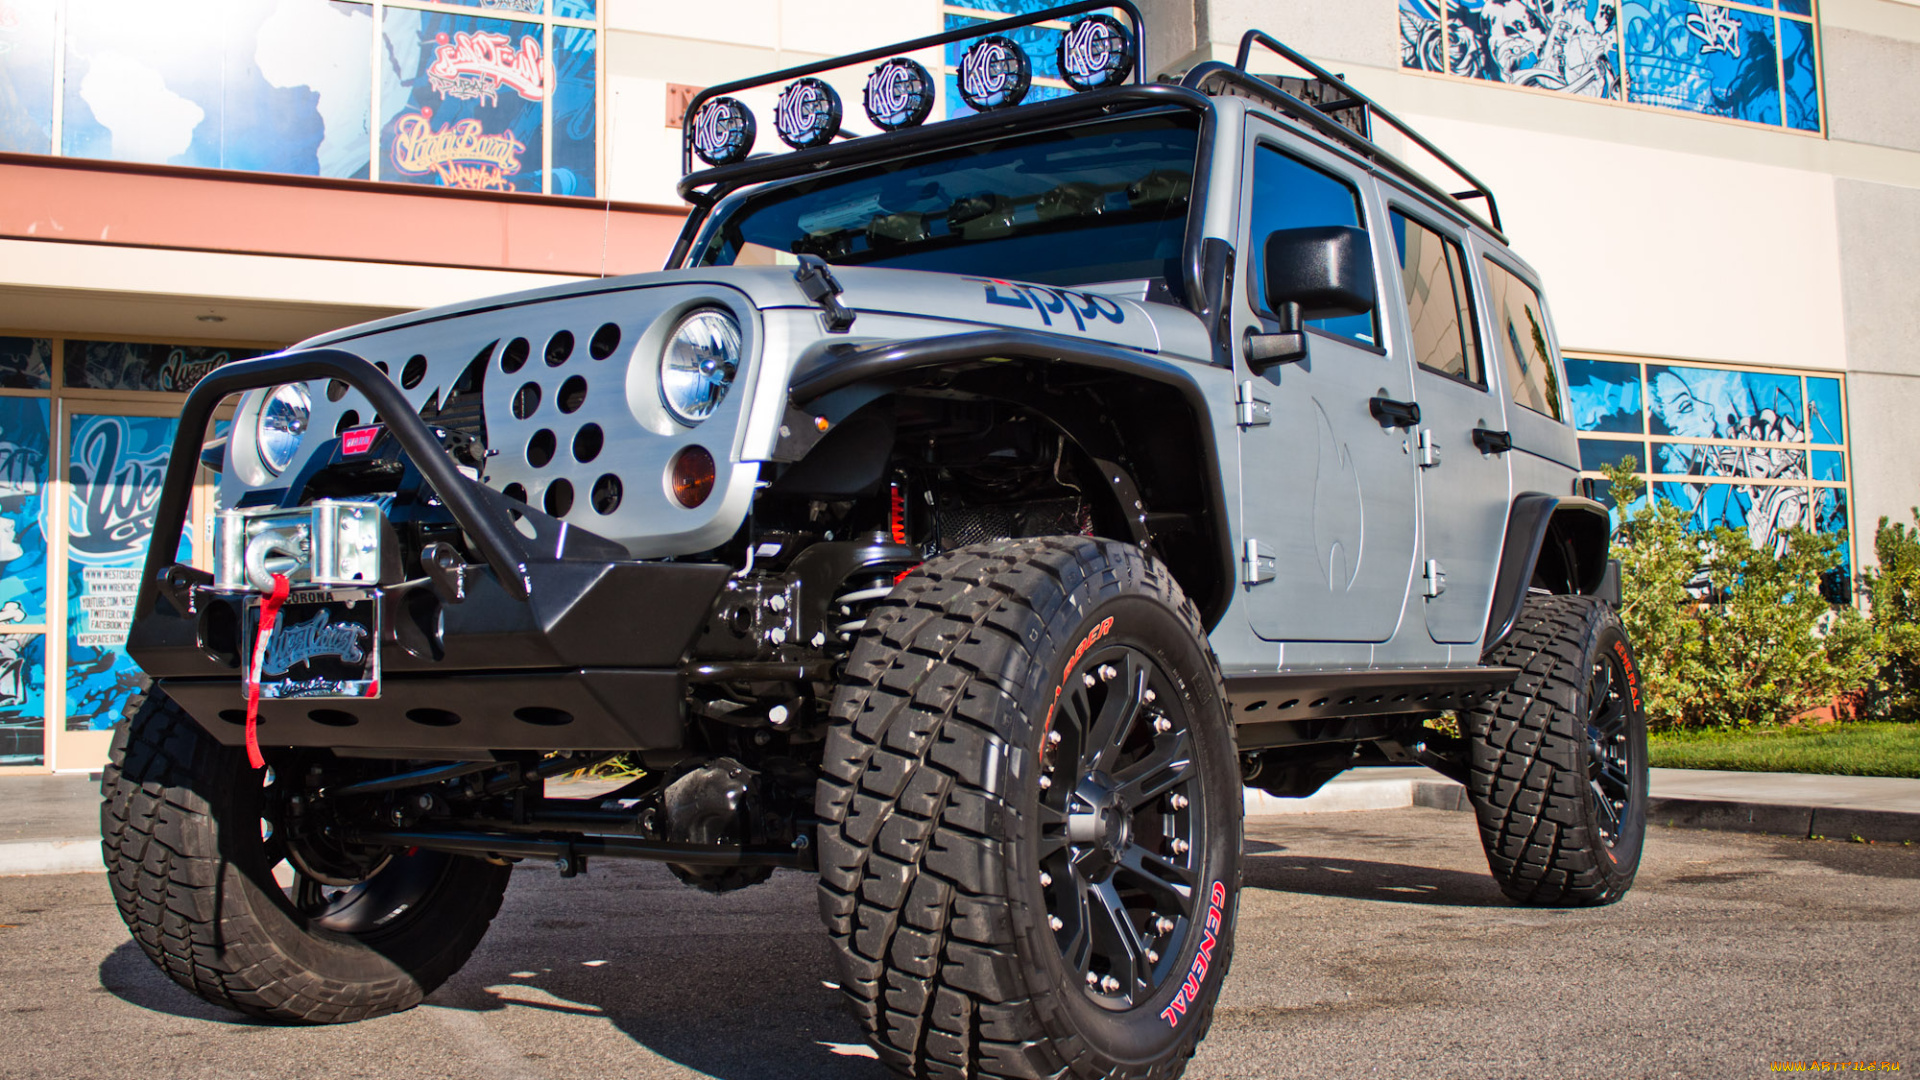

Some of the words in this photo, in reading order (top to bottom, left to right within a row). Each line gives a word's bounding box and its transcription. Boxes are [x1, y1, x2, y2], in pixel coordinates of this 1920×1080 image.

[963, 42, 1006, 97] KC
[1065, 20, 1109, 76] KC
[779, 84, 816, 136] KC
[869, 64, 909, 116] KC
[694, 102, 730, 151] KC
[69, 419, 168, 553] We
[284, 591, 334, 604] CORONA
[91, 619, 132, 630] FACEBOOK.CO
[1614, 640, 1640, 712] GENERAL
[1160, 880, 1227, 1028] GENERAL
